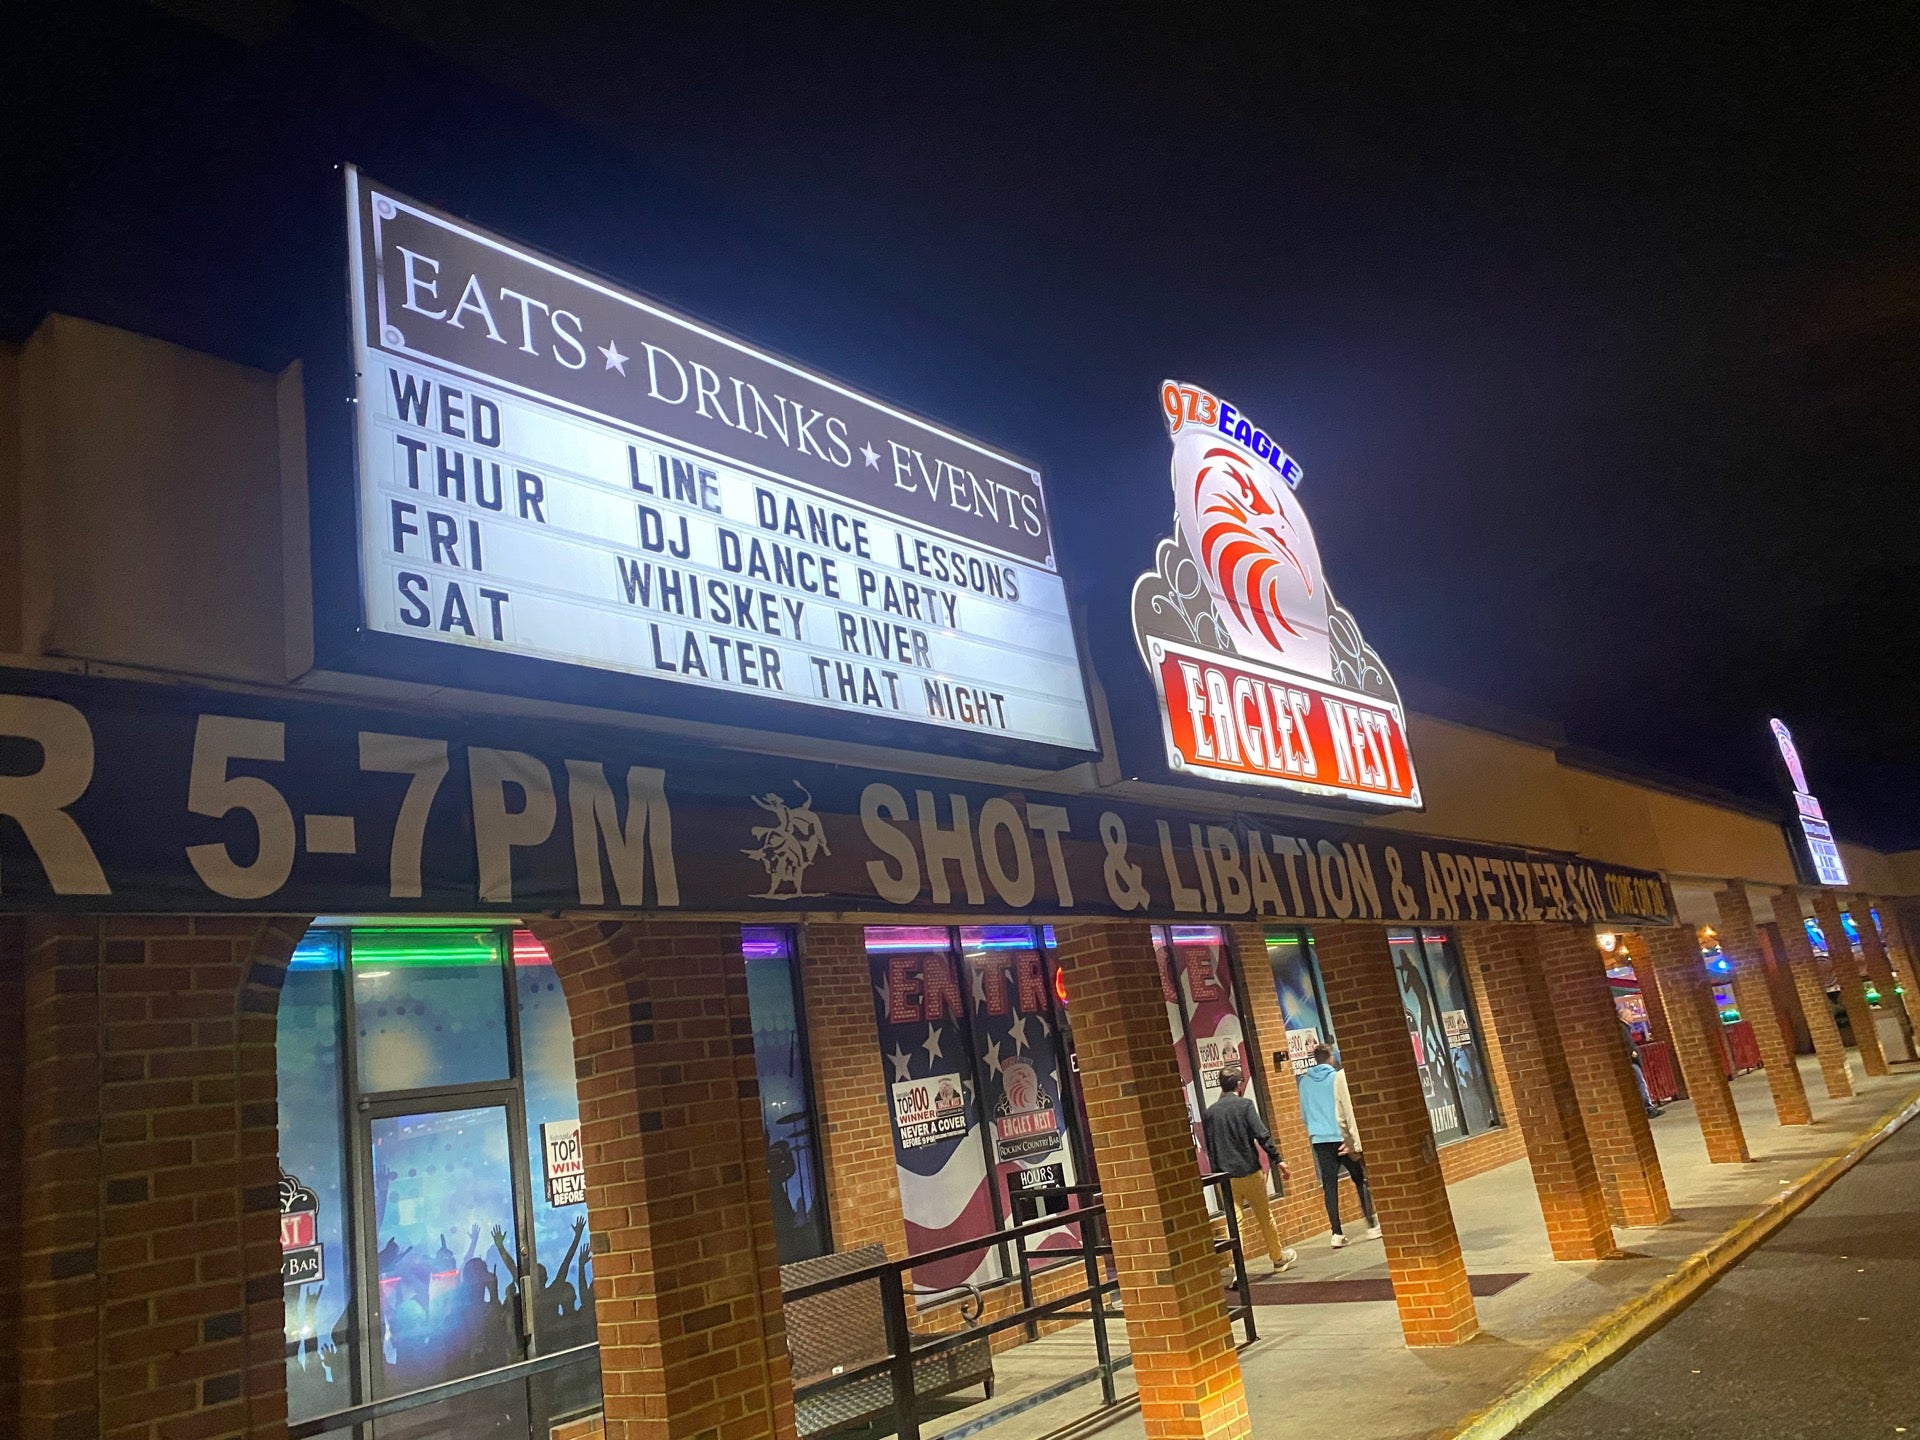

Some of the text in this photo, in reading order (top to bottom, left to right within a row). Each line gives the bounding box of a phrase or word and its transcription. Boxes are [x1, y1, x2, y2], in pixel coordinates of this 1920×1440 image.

[389, 368, 500, 448] WED
[396, 245, 1041, 537] EATS DRINKS EVENTS
[1219, 402, 1300, 486] EAGLE
[397, 434, 957, 628] THUR DJ DANCE PARTY
[628, 445, 1019, 602] LINE DANCE LESSONS
[391, 499, 932, 668] FRI WHISKEY RIVER
[398, 571, 1006, 729] SAT LATER THAT NIGHT
[1321, 696, 1402, 792] NEST
[859, 783, 1074, 908] SHOT
[1100, 810, 1150, 912] &
[1156, 818, 1382, 920] LIBATION
[1385, 845, 1419, 920] &
[1421, 850, 1573, 921] APPETIZER
[1565, 860, 1606, 923] $10
[899, 1110, 935, 1124] WINNER
[901, 1123, 929, 1139] NEVER
[931, 1121, 937, 1134] A
[938, 1115, 966, 1131] COVER
[902, 1137, 921, 1149] BEFORE
[1034, 1112, 1051, 1132] NEST
[552, 1161, 580, 1174] WIN
[1022, 1138, 1049, 1152] COUNTRY
[554, 1190, 584, 1206] BEFORE
[1020, 1166, 1054, 1185] HOURS
[290, 1258, 318, 1276] BAR
